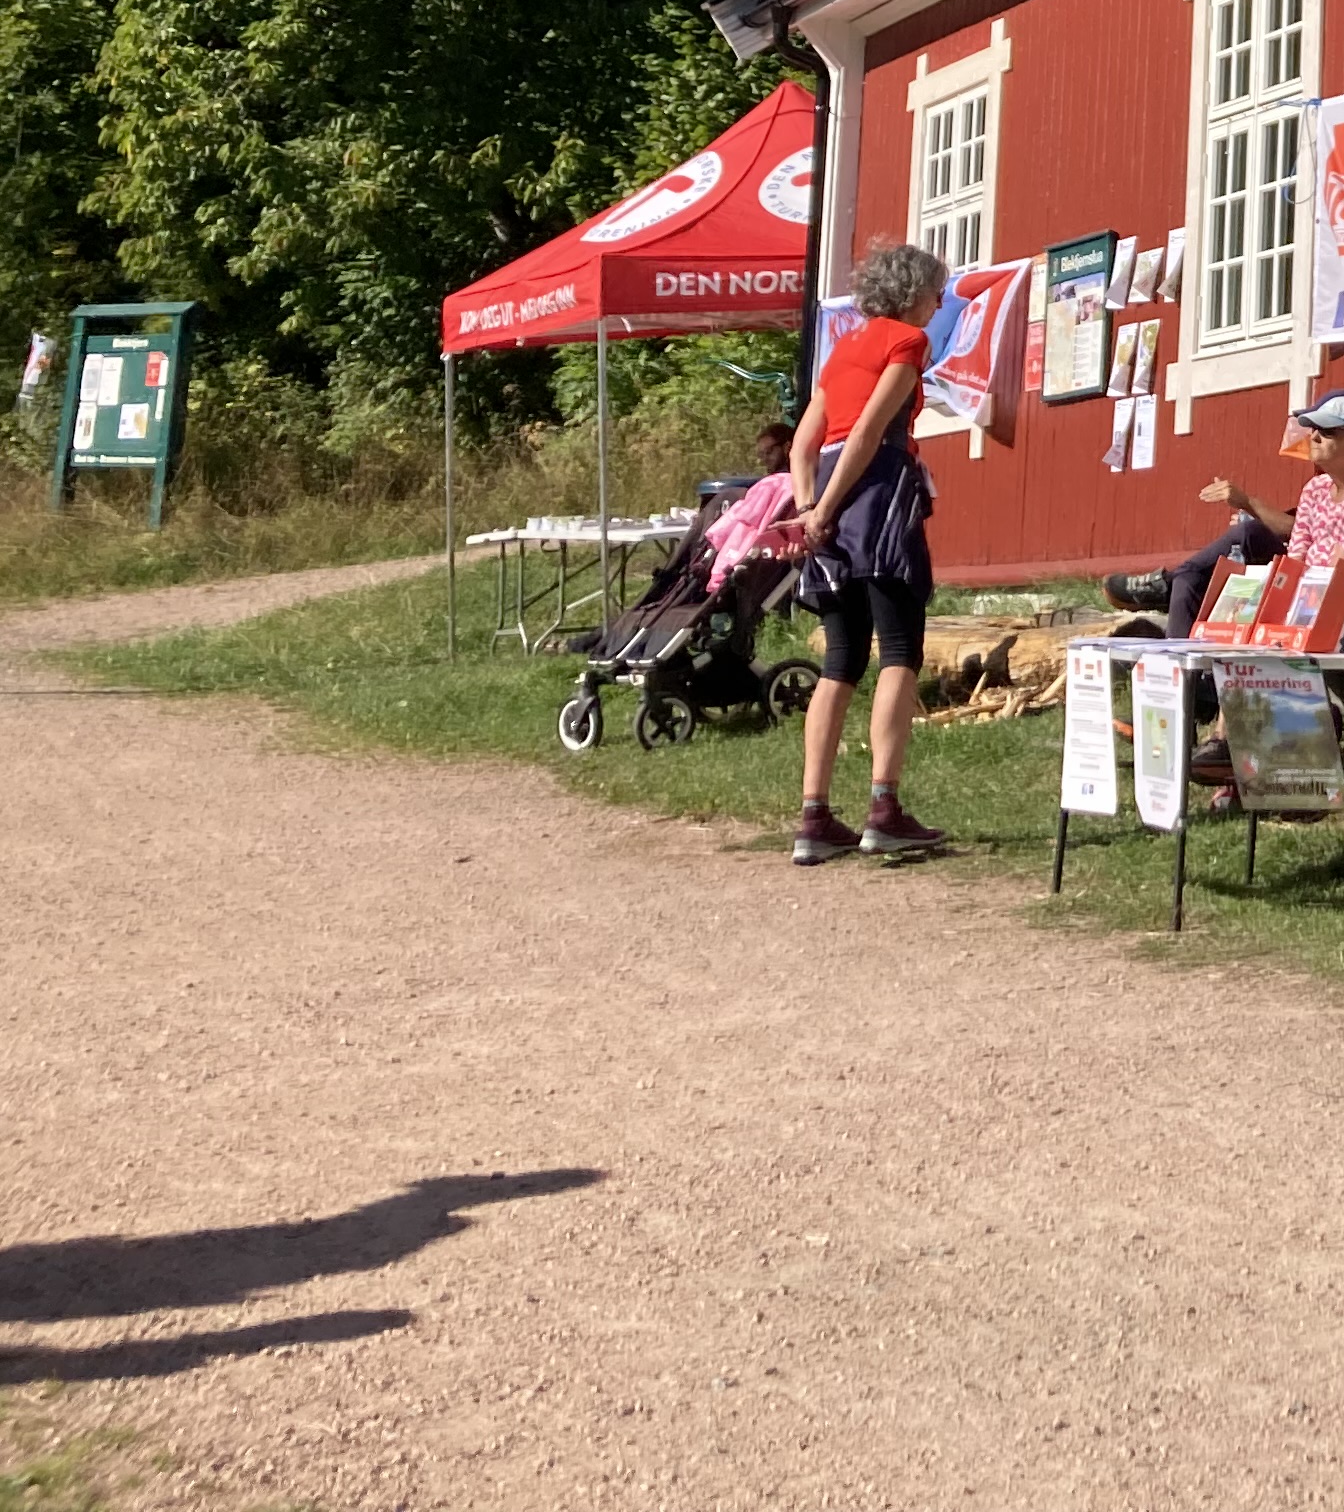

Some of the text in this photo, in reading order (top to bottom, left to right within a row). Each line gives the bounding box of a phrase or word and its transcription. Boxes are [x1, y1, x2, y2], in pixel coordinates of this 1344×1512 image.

[655, 269, 804, 297] DEN NOR
[1223, 661, 1262, 676] Tur-
[1223, 677, 1312, 692] orientering
